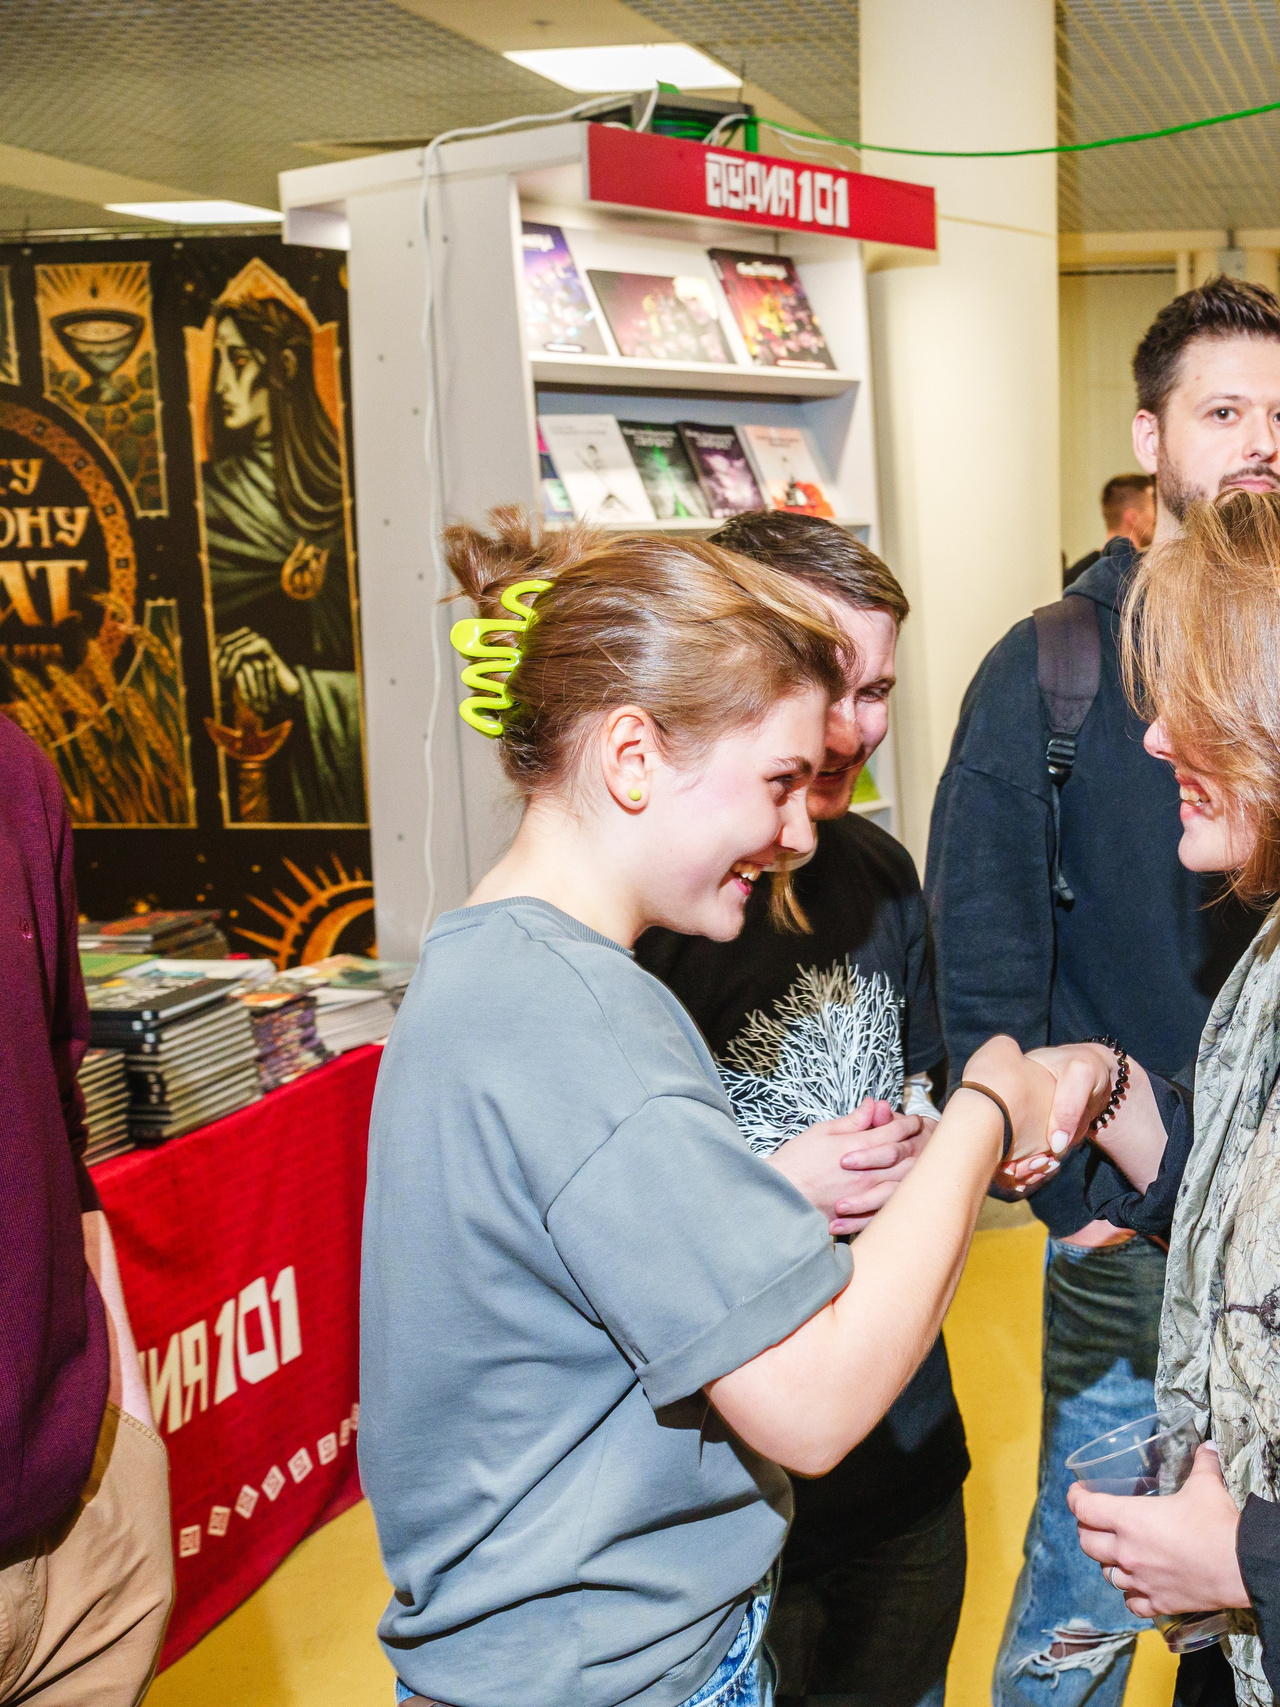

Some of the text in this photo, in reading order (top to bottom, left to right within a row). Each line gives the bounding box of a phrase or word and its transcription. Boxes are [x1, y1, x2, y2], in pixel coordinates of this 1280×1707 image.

[705, 152, 850, 228] СТУДИЯ 101
[137, 1264, 303, 1434] ИЯ 101
